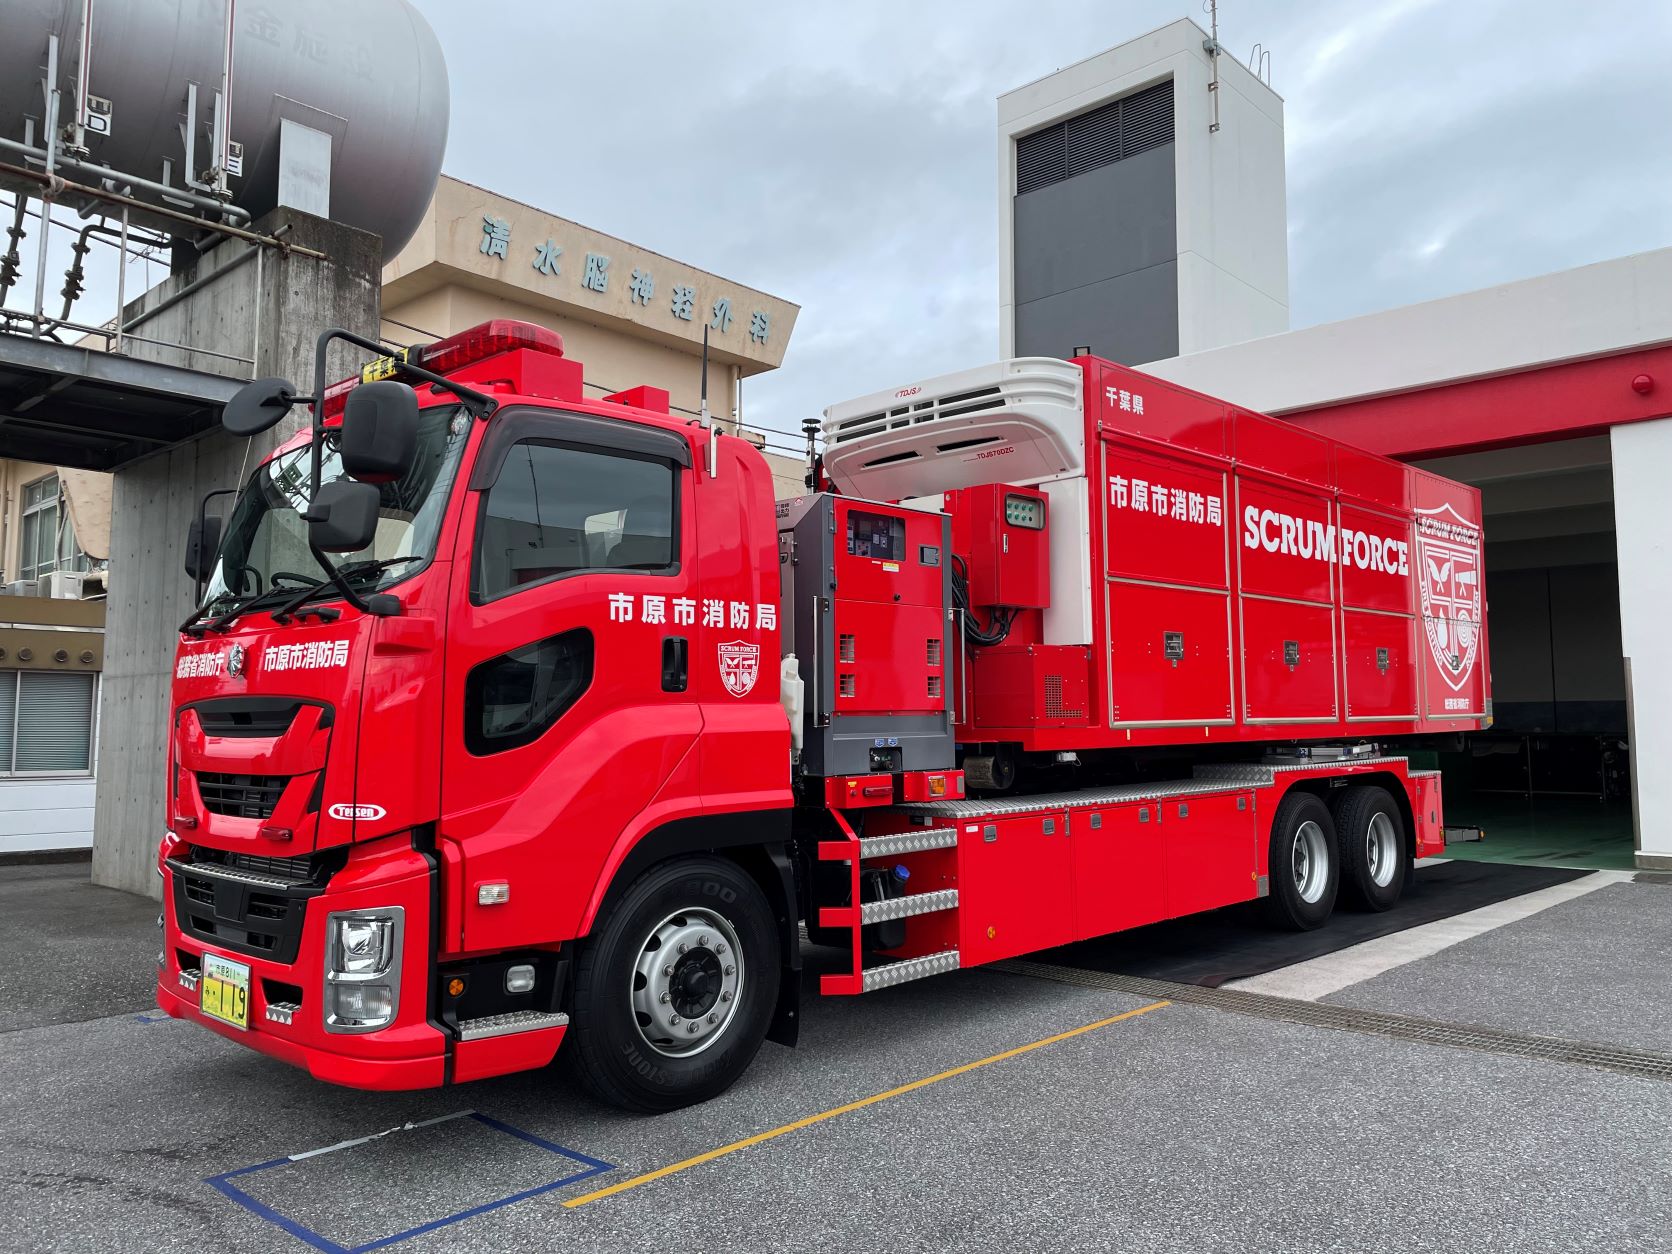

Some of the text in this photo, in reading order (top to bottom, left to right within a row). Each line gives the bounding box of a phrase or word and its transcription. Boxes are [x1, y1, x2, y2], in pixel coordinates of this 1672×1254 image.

[480, 213, 770, 345] 清水脳神経外科
[1106, 386, 1144, 416] 千葉県
[1109, 475, 1222, 527] 市原市消防局
[1244, 505, 1409, 576] SCRUM FORCE
[1420, 516, 1479, 546] SCRUM FORCE
[608, 592, 777, 631] 市原市消防局
[264, 639, 350, 672] 市原市消防局
